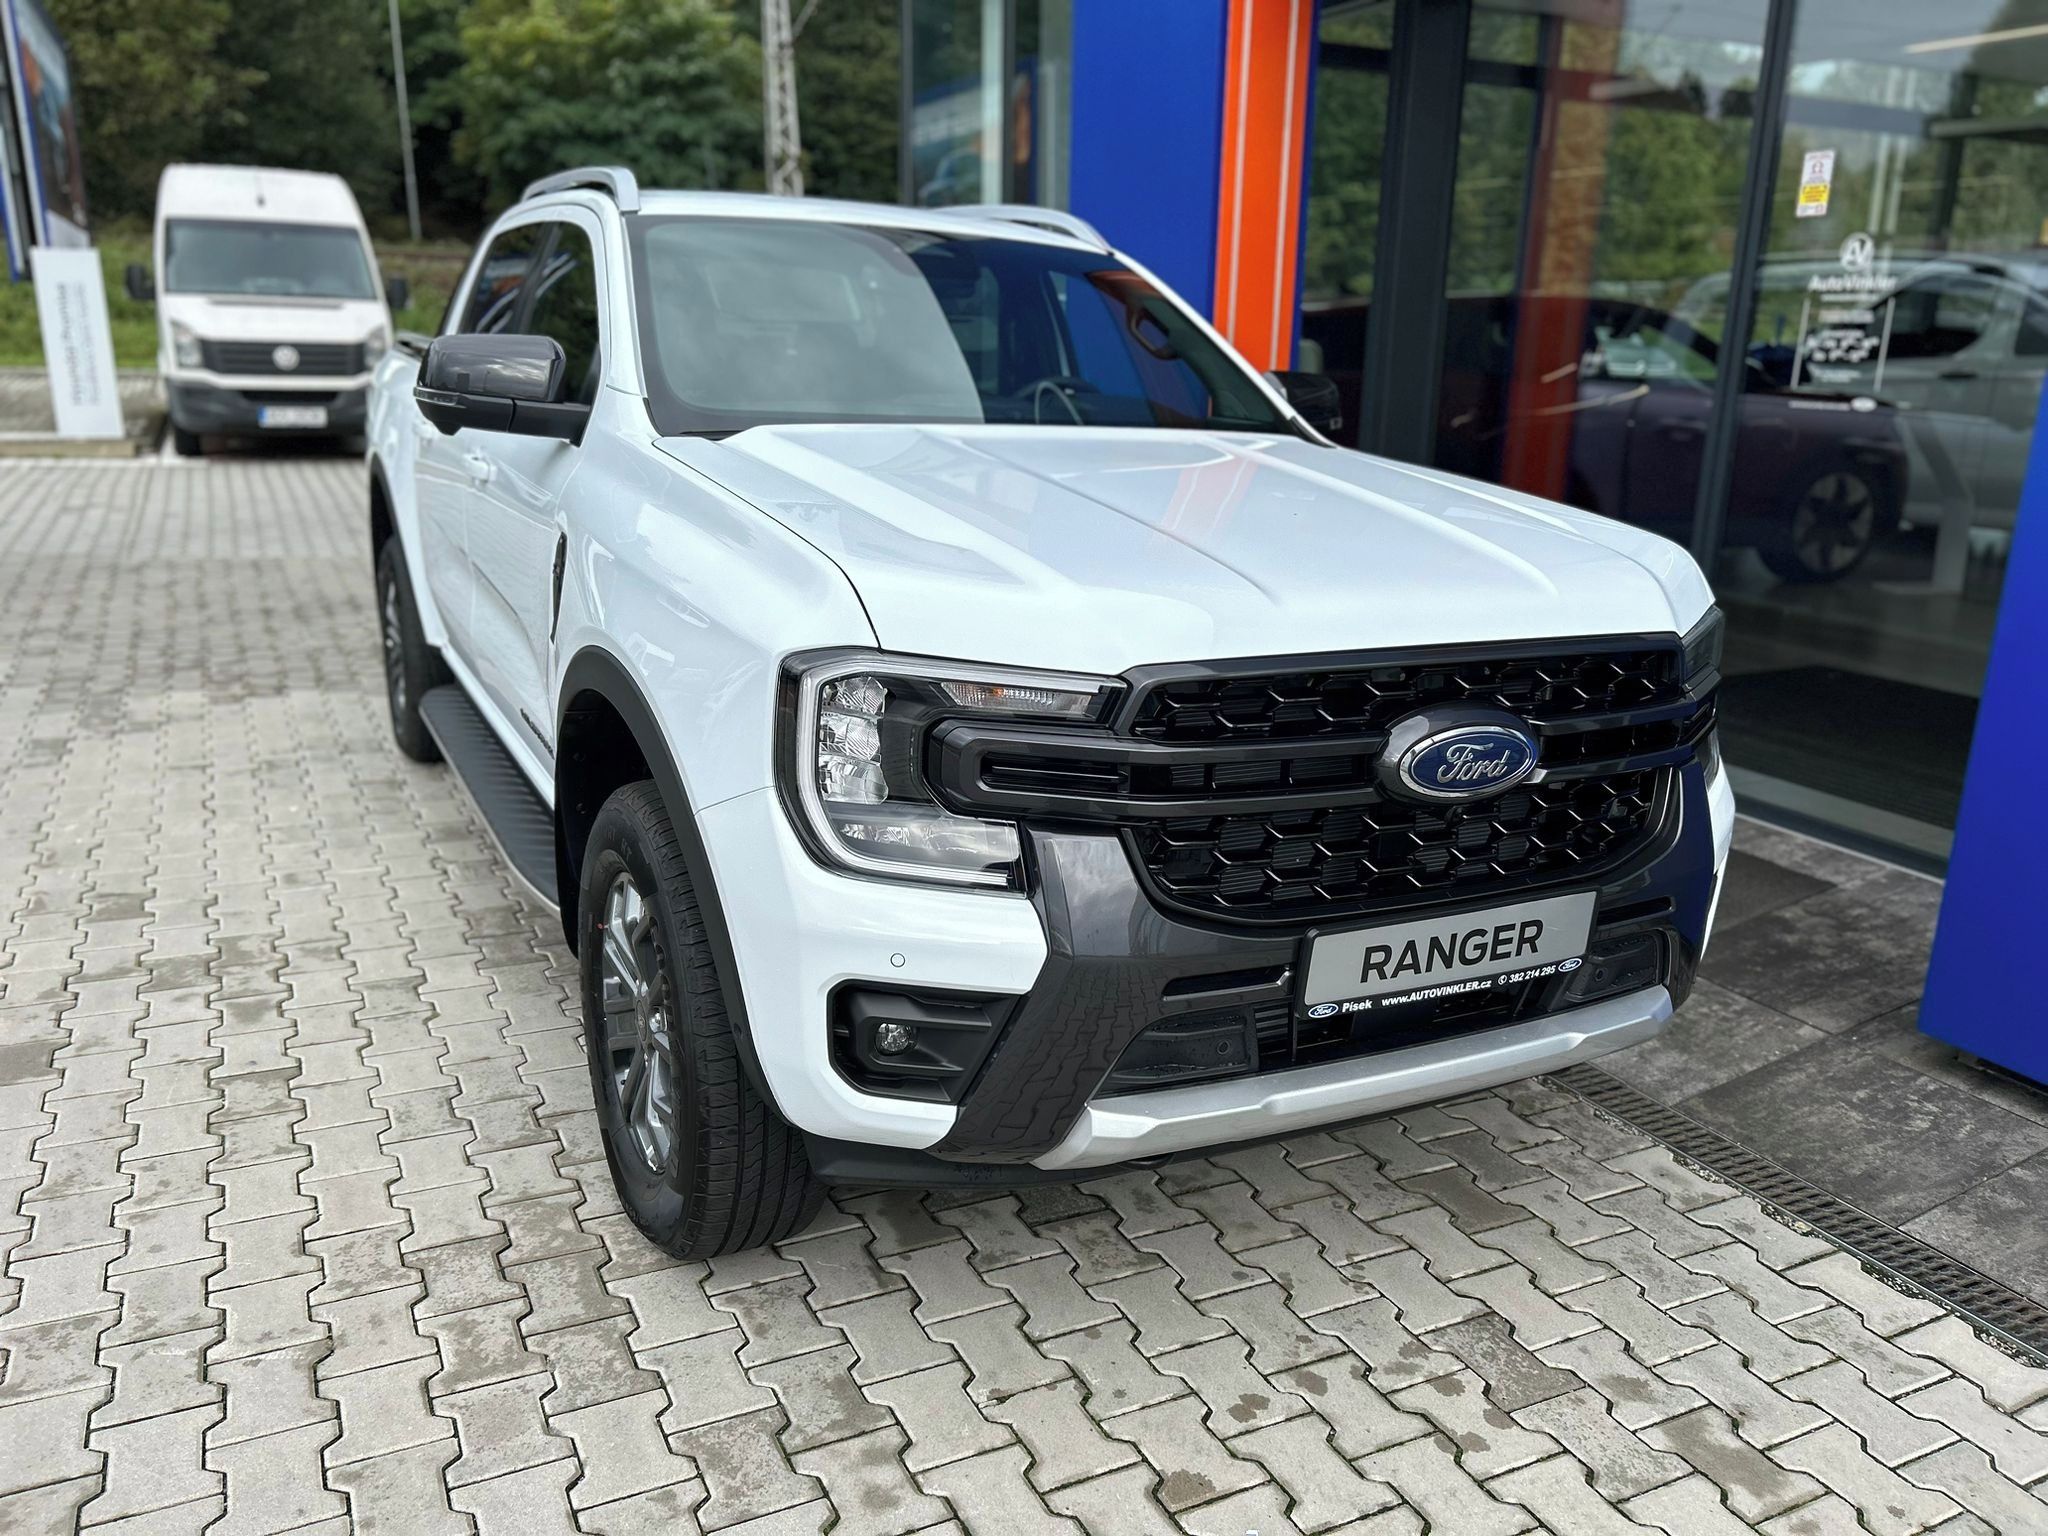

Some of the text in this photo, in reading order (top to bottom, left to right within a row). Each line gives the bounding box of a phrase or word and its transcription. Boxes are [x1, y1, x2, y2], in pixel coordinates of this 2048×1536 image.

[1437, 742, 1511, 783] Ford
[1360, 919, 1544, 983] RANGER
[1381, 980, 1492, 1006] www.AUTOVINKLER.cz
[1509, 972, 1524, 983] 382
[1525, 968, 1540, 979] 214
[1541, 965, 1556, 976] 295
